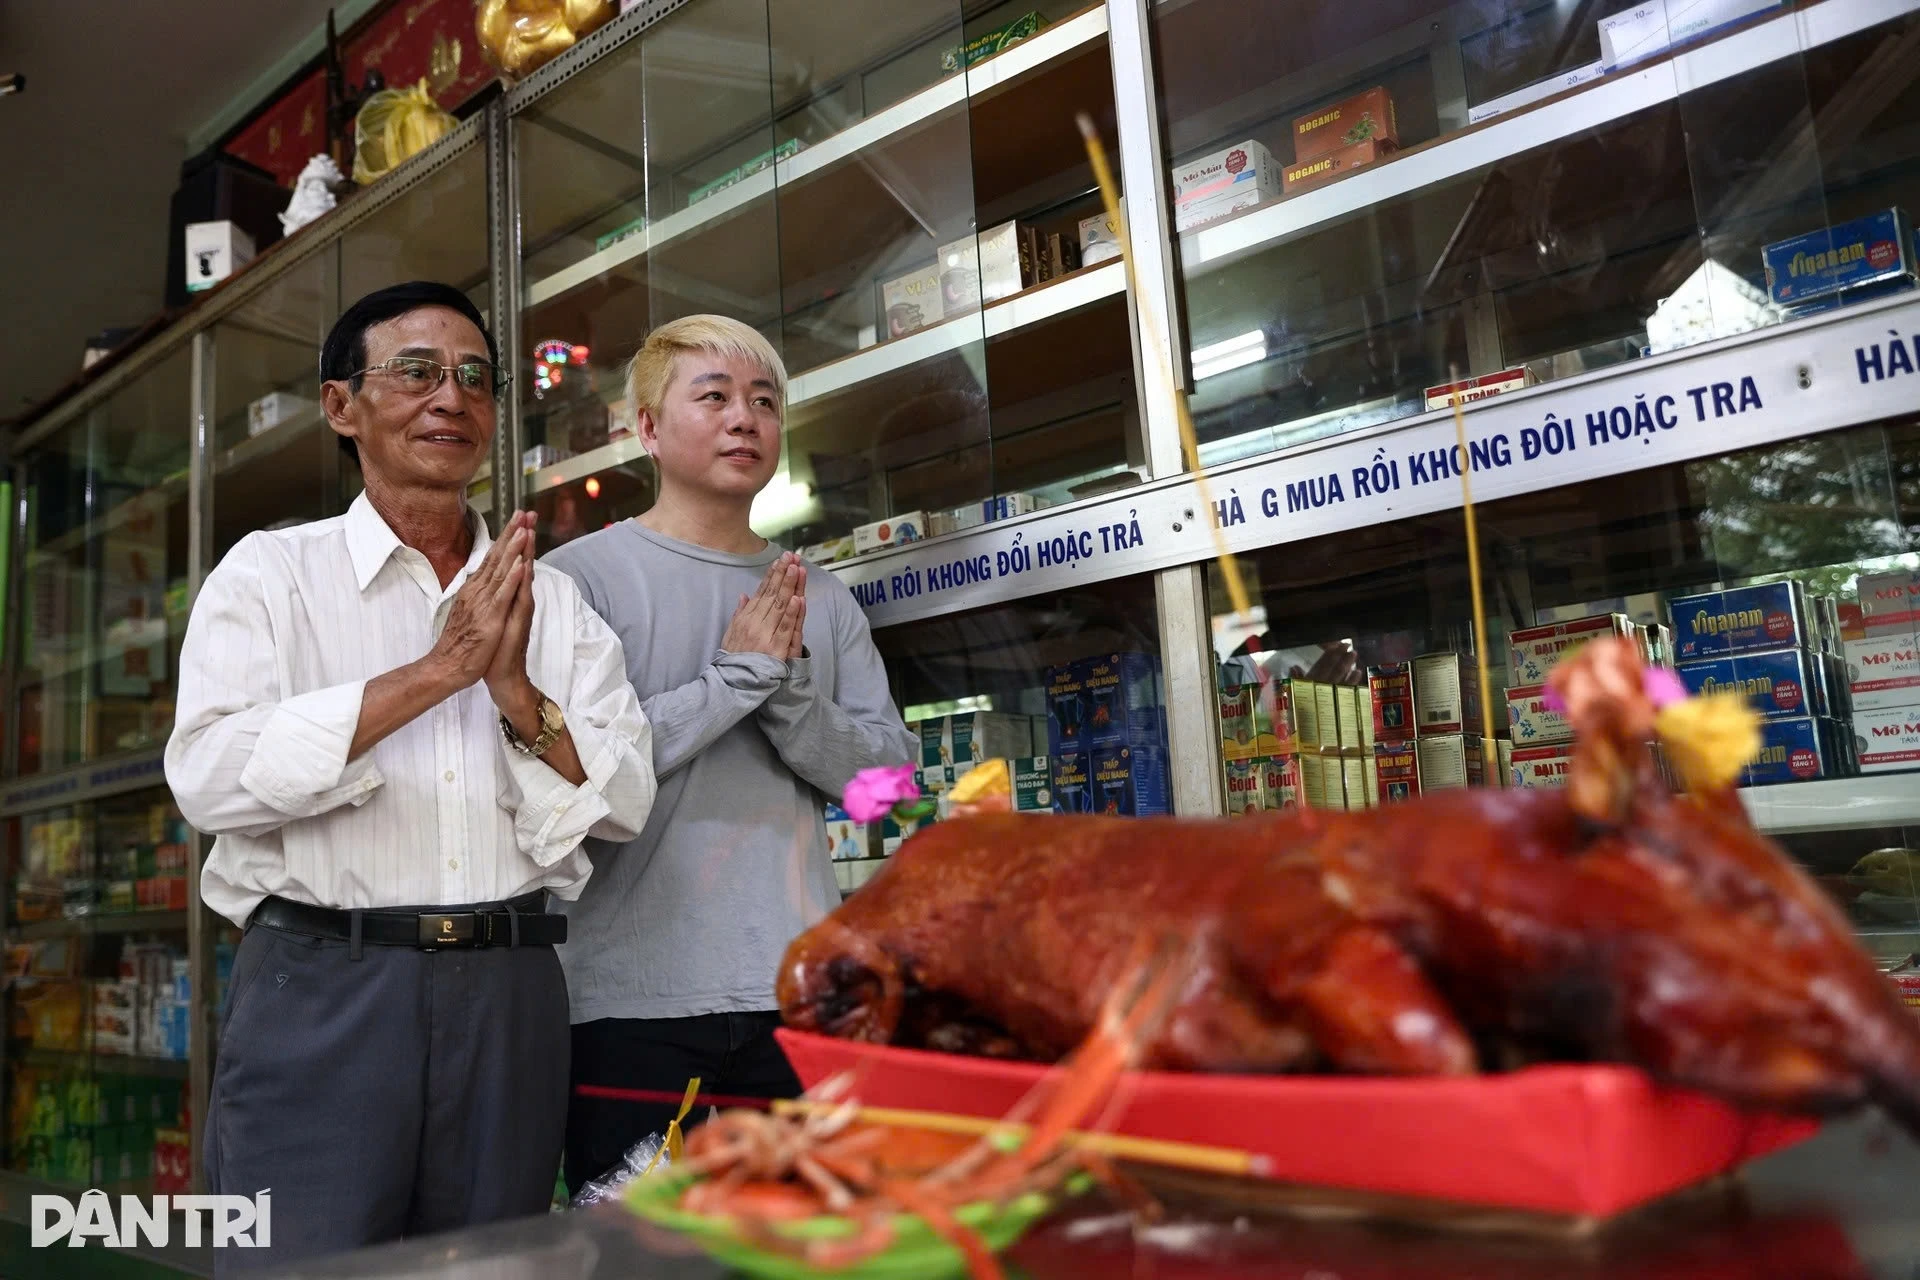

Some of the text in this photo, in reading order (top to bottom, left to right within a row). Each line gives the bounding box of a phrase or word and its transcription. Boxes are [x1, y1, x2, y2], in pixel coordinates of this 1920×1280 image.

[1299, 110, 1341, 134] BOGANIC
[1288, 159, 1331, 182] BOGANIC
[1788, 242, 1866, 278] Viganam
[1286, 473, 1345, 513] MUA
[1352, 448, 1400, 498] RỒI
[1520, 413, 1576, 461] ĐÔI
[1585, 393, 1677, 446] HOẶC
[1687, 376, 1763, 422] TRA
[891, 566, 922, 600] RÔI
[927, 555, 992, 592] KHONG
[997, 532, 1031, 577] ĐỔI
[1037, 530, 1093, 569] HOẶC
[1098, 509, 1144, 553] TRẢ
[1691, 609, 1764, 637] Viganam
[1229, 776, 1257, 792] Gout
[1268, 771, 1297, 788] Gout
